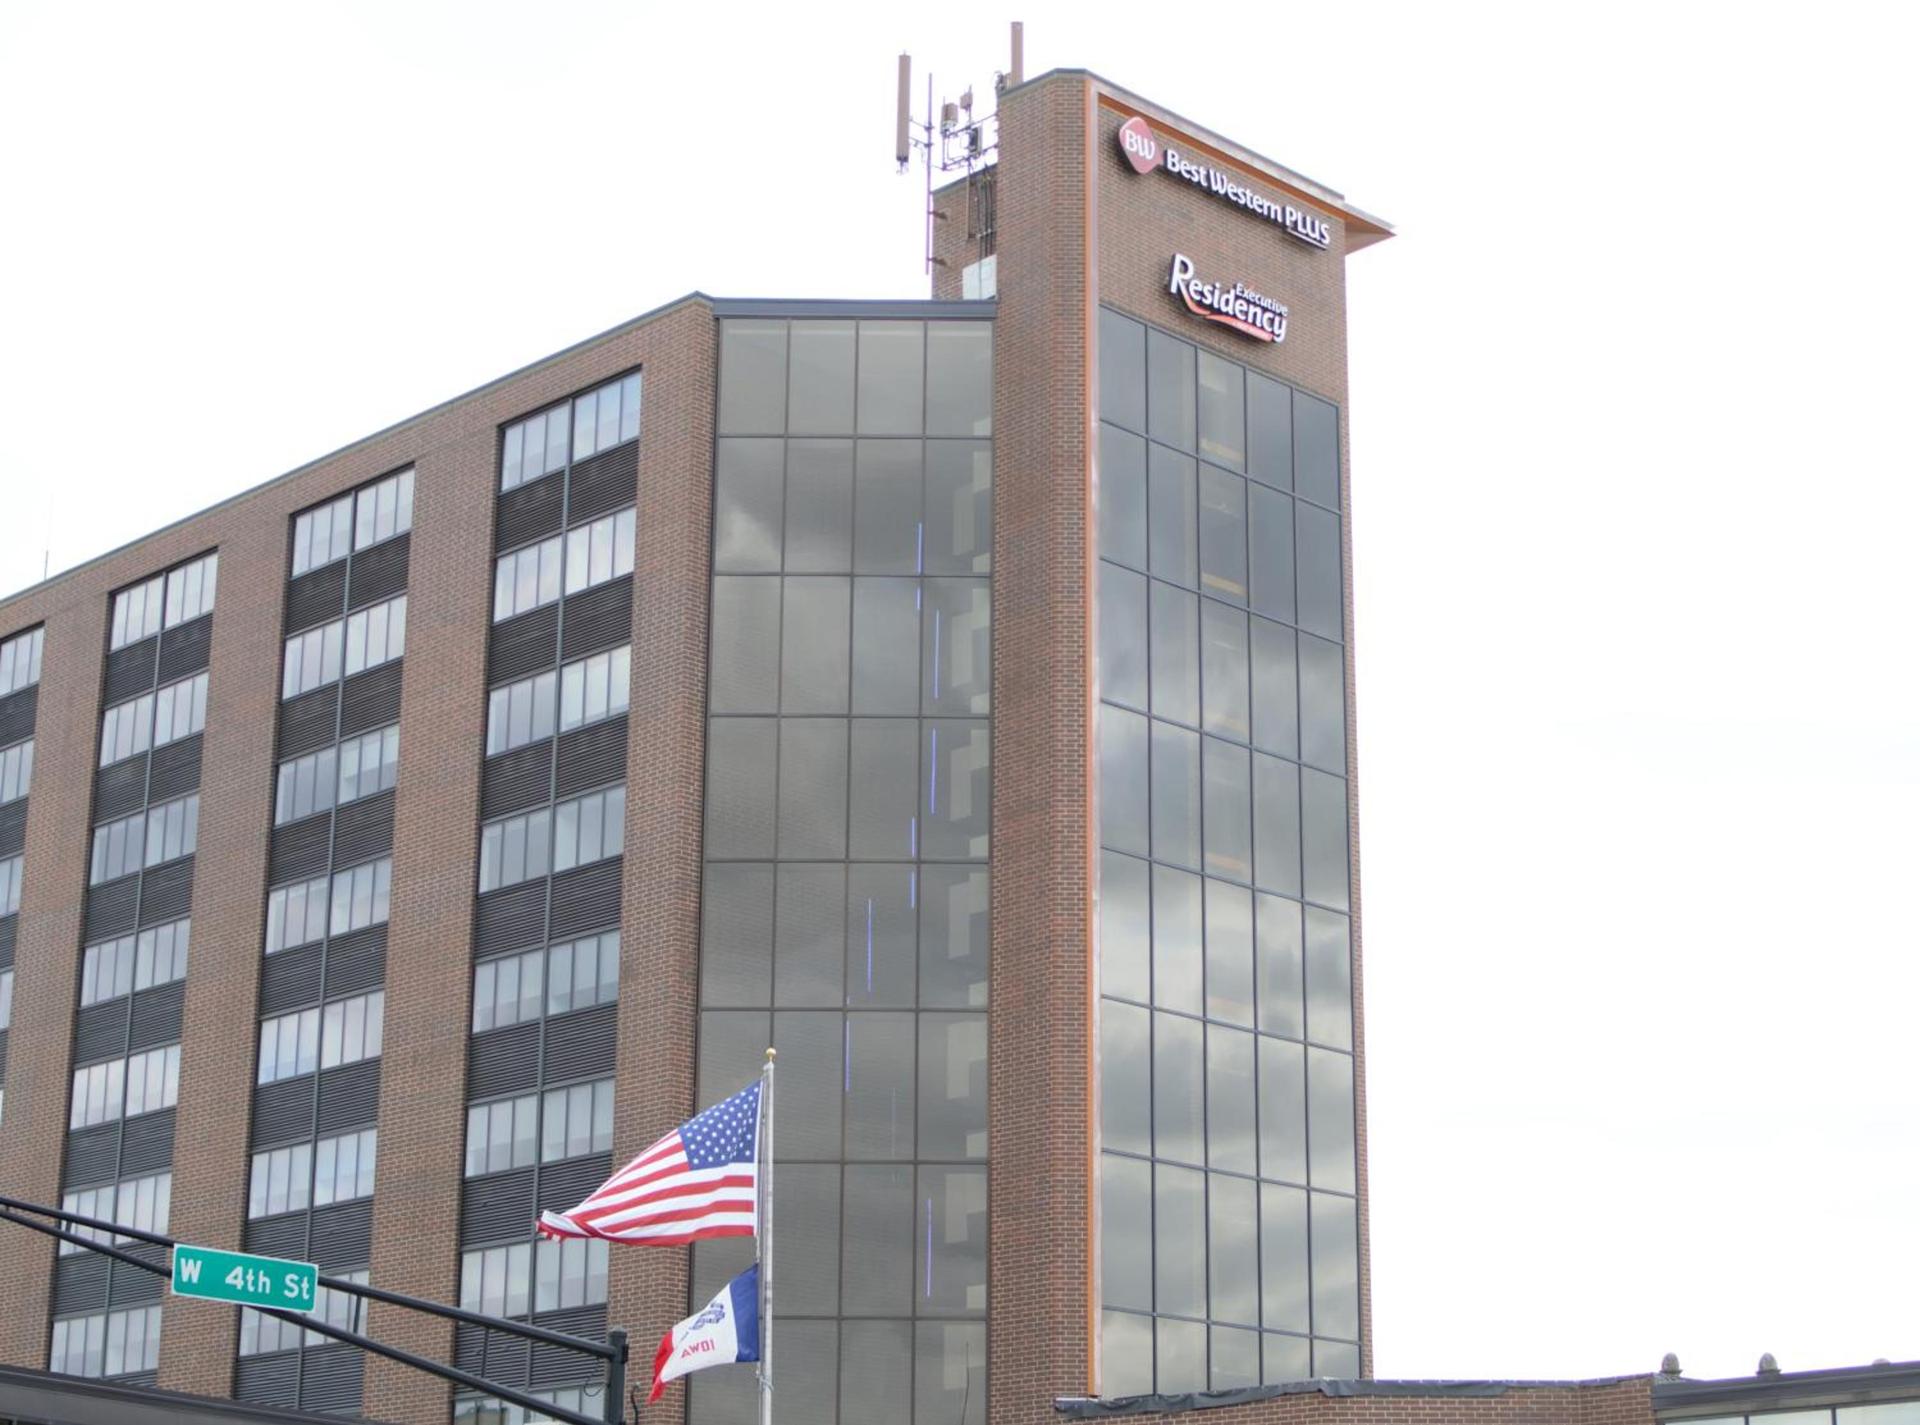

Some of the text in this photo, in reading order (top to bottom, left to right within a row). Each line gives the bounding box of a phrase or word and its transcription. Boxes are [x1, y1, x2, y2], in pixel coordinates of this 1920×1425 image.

[1124, 129, 1155, 160] BW
[1166, 149, 1331, 246] Best Western PLUS
[1170, 253, 1288, 343] Residency
[1235, 283, 1288, 316] Executive
[180, 1258, 310, 1300] W 4th St
